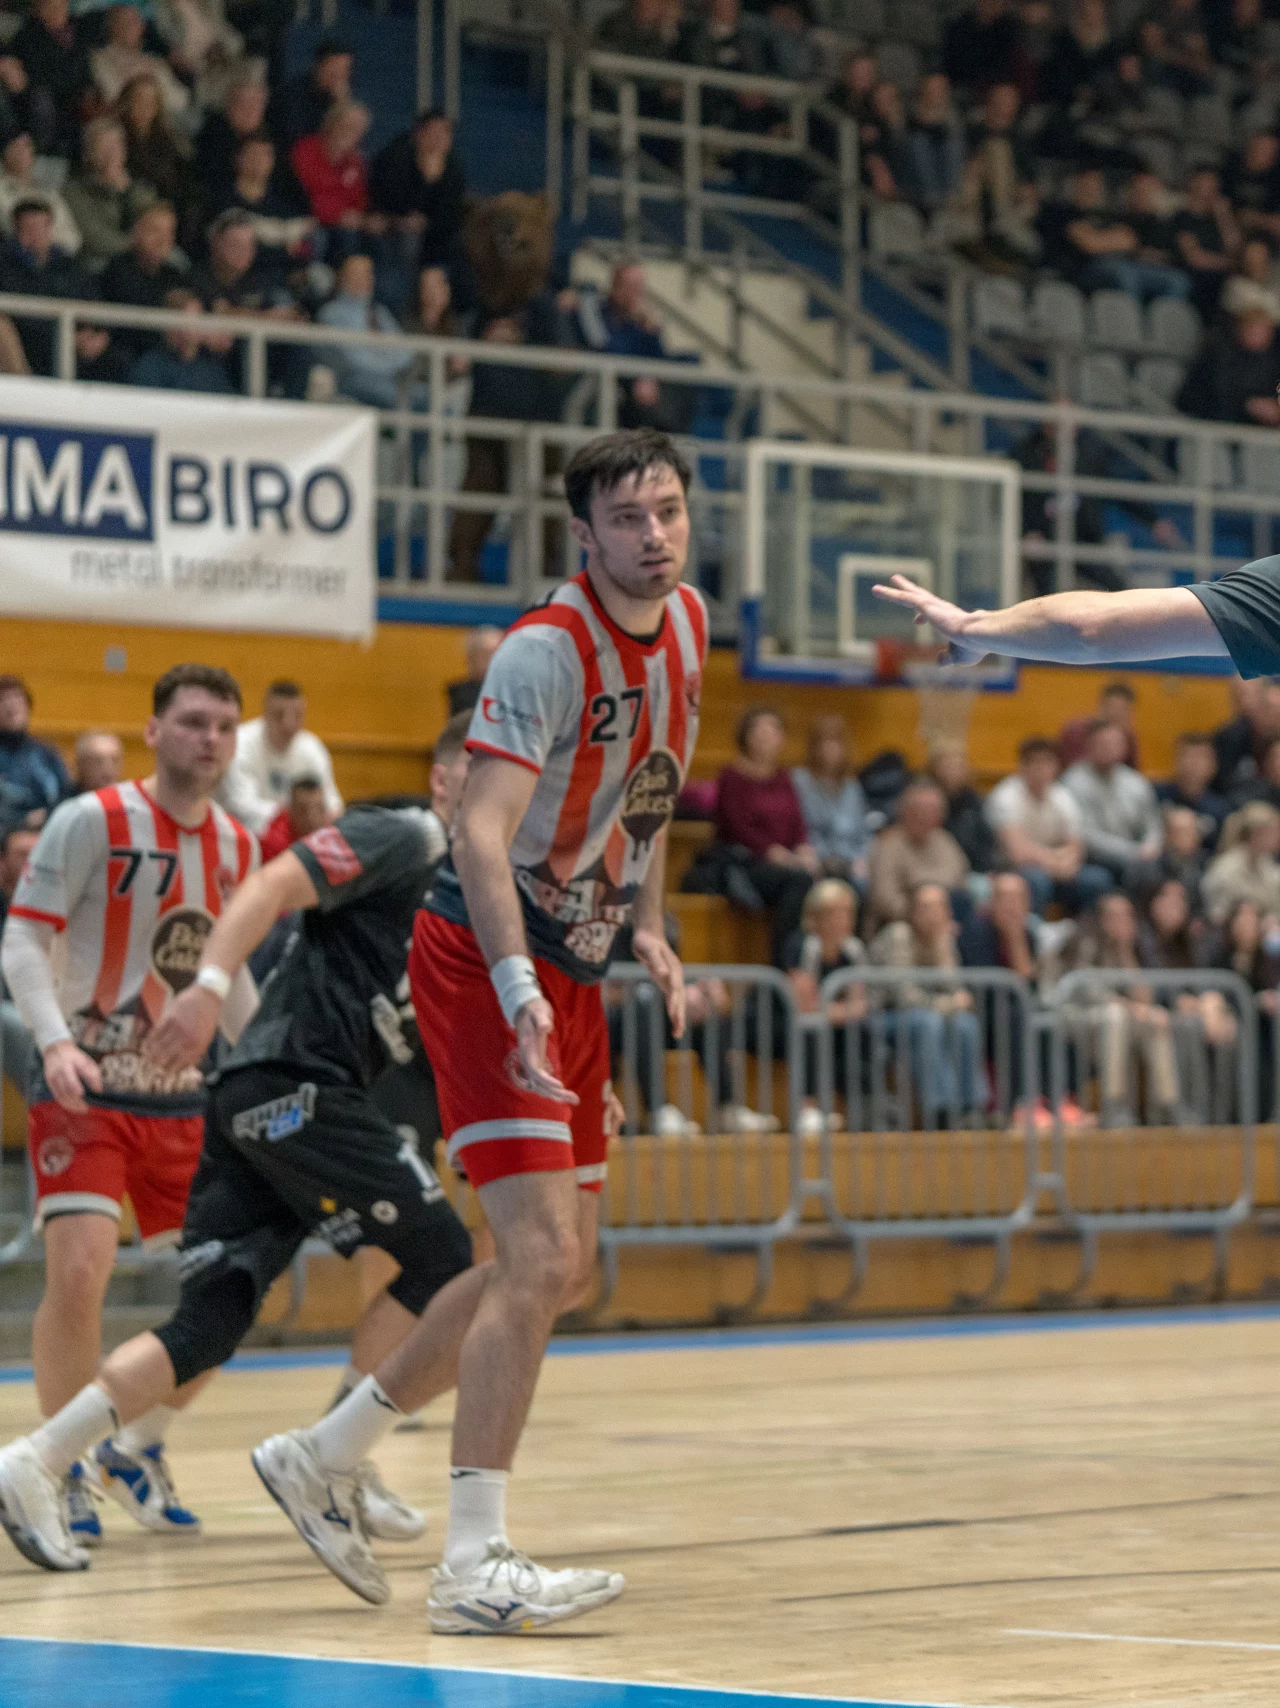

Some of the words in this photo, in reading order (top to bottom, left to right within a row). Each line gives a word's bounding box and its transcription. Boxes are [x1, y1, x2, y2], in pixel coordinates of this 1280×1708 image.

[168, 453, 352, 534] BIRO
[589, 687, 644, 744] 27
[109, 847, 179, 898] 77
